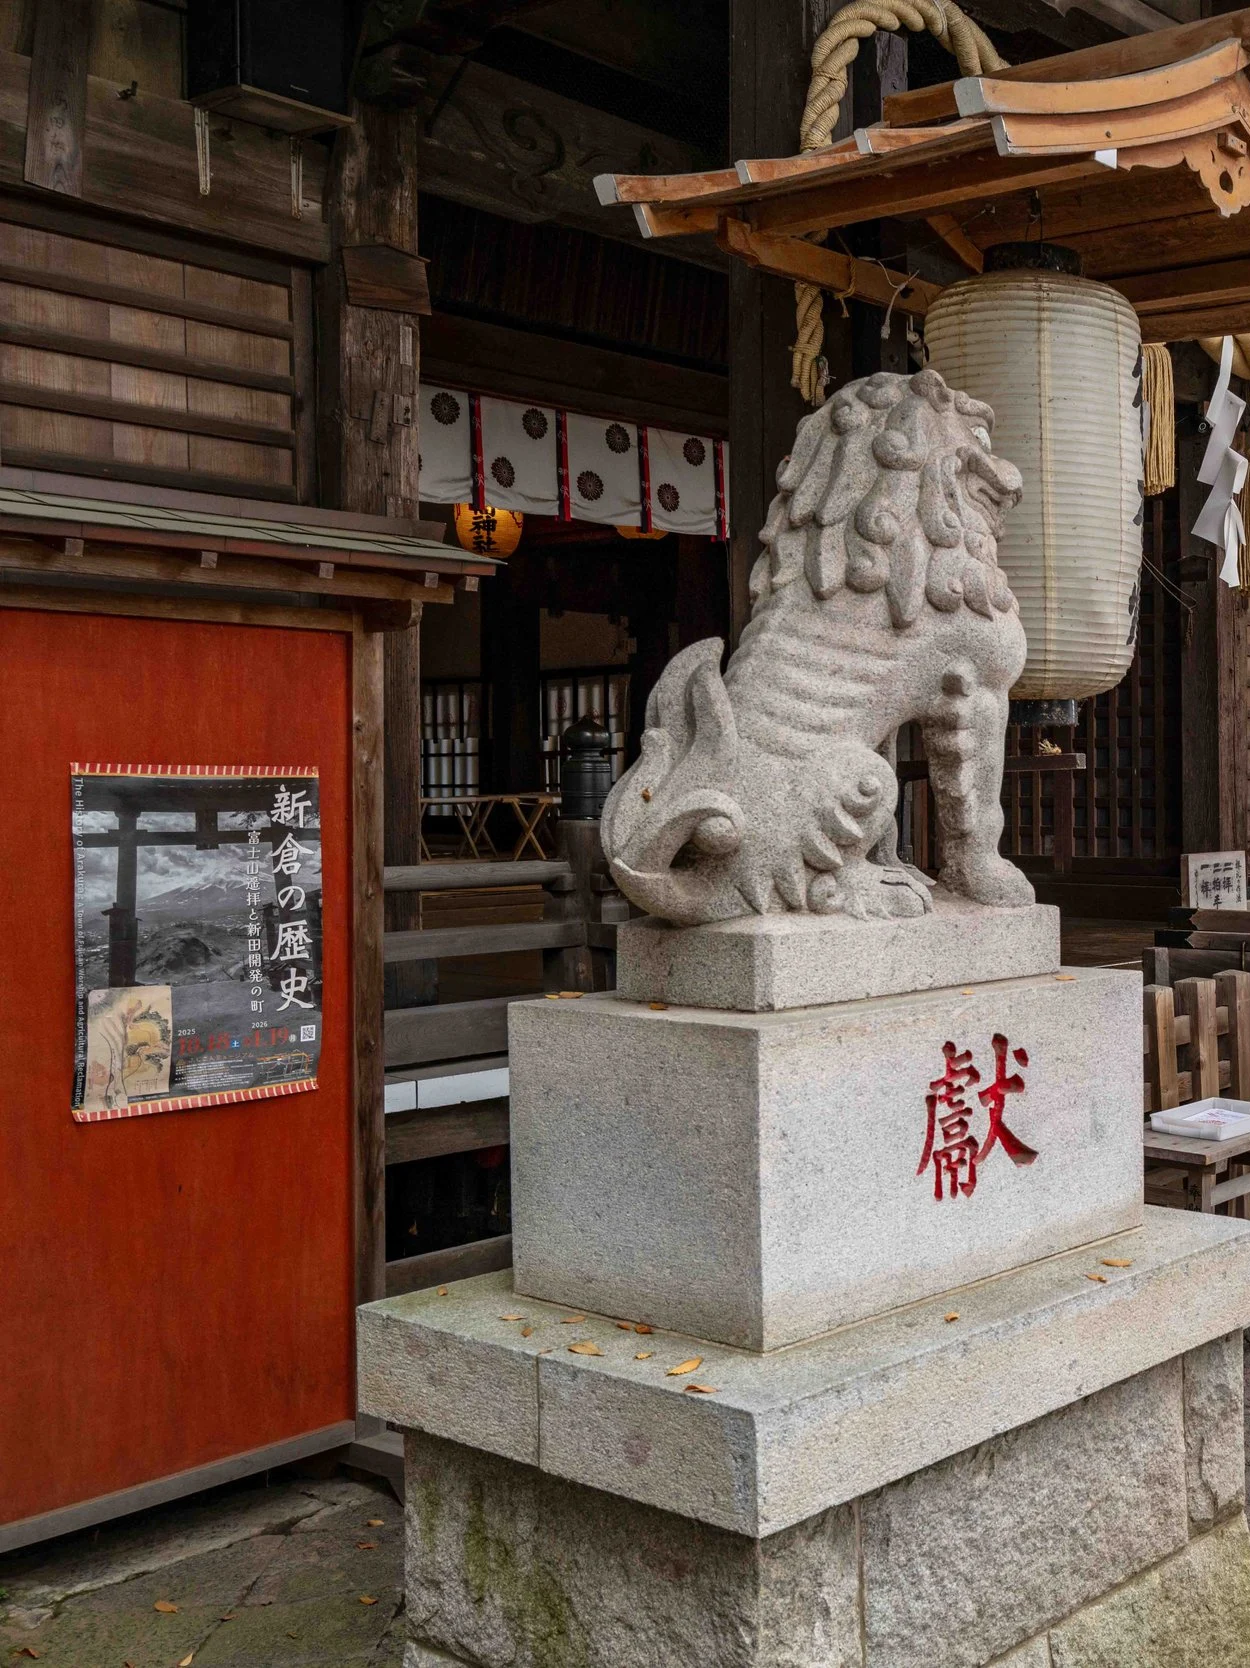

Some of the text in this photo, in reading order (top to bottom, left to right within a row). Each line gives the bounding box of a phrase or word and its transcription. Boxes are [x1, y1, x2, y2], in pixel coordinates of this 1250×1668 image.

[75, 778, 84, 797] The
[75, 800, 85, 838] History
[76, 840, 86, 852] of
[269, 784, 315, 1013] 新倉の歴史
[1212, 863, 1222, 910] 二拍手
[77, 930, 85, 939] of
[78, 940, 86, 967] Fujisan
[77, 968, 86, 999] Worship
[76, 1016, 87, 1061] Agricultural
[177, 1028, 196, 1036] 2025
[251, 1021, 268, 1029] 2026
[74, 1062, 85, 1107] Reclamation
